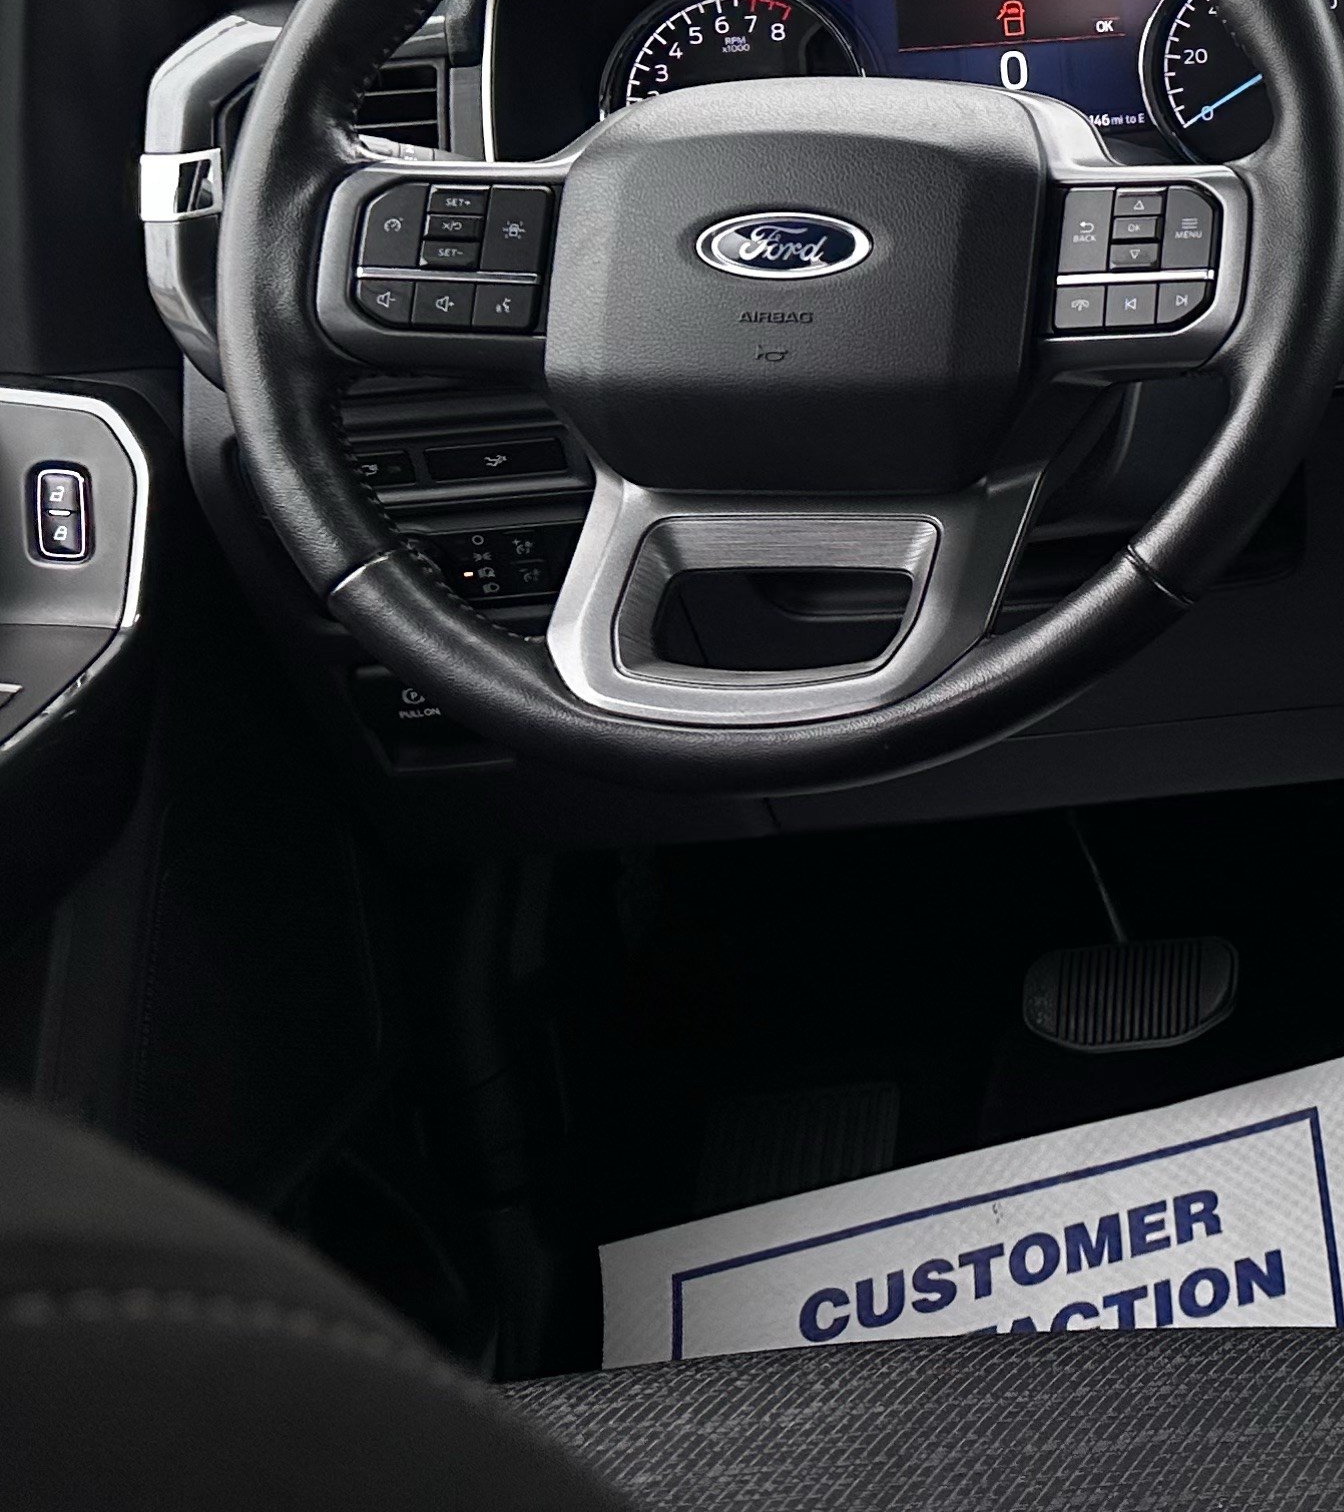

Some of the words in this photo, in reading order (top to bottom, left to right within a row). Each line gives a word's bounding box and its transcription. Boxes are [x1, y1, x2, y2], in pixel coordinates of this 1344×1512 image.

[714, 15, 730, 34] 6
[743, 15, 758, 33] 7
[770, 22, 786, 41] 8
[1095, 20, 1114, 33] OK
[688, 26, 704, 45] 5
[724, 36, 746, 46] RPM
[668, 41, 683, 59] 4
[1183, 48, 1208, 65] 20
[654, 64, 669, 83] 3
[1000, 50, 1028, 90] 0
[1125, 114, 1137, 124] to
[1138, 112, 1146, 124] E
[740, 225, 828, 262] Ford
[1073, 234, 1097, 243] BACK
[1175, 230, 1203, 239] MENU
[739, 311, 815, 324] AIRBAG
[399, 708, 421, 718] PULL
[421, 706, 441, 718] ON
[799, 1189, 1222, 1343] CUSTOMER
